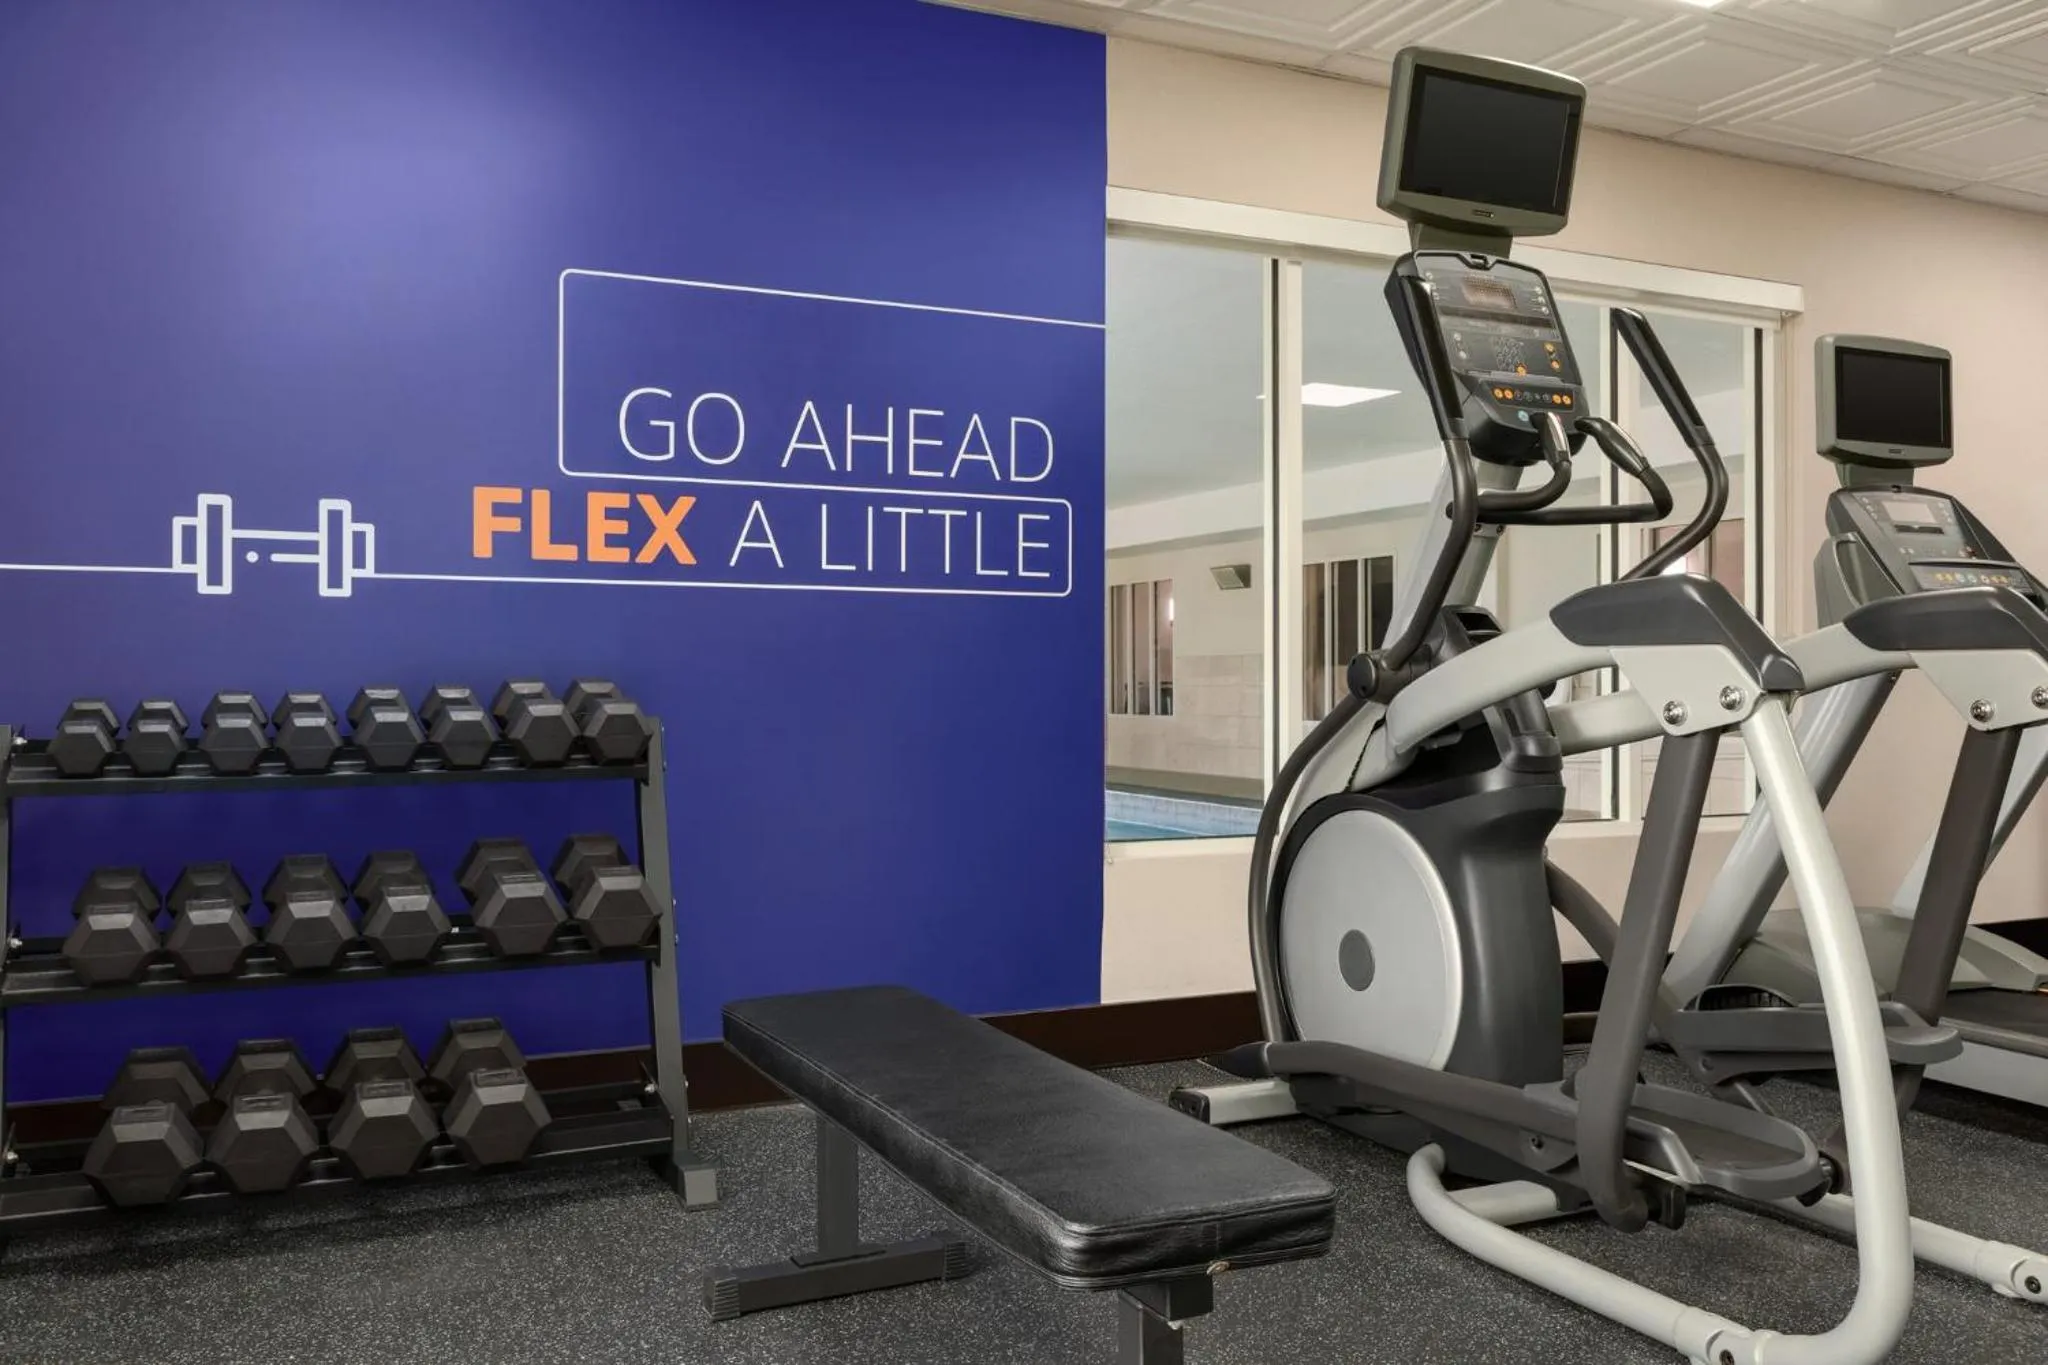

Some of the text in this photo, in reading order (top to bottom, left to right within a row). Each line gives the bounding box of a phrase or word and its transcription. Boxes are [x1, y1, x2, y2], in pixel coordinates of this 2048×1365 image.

[619, 386, 1054, 483] GO AHEAD
[472, 485, 1050, 578] FLEX A LITTLE
